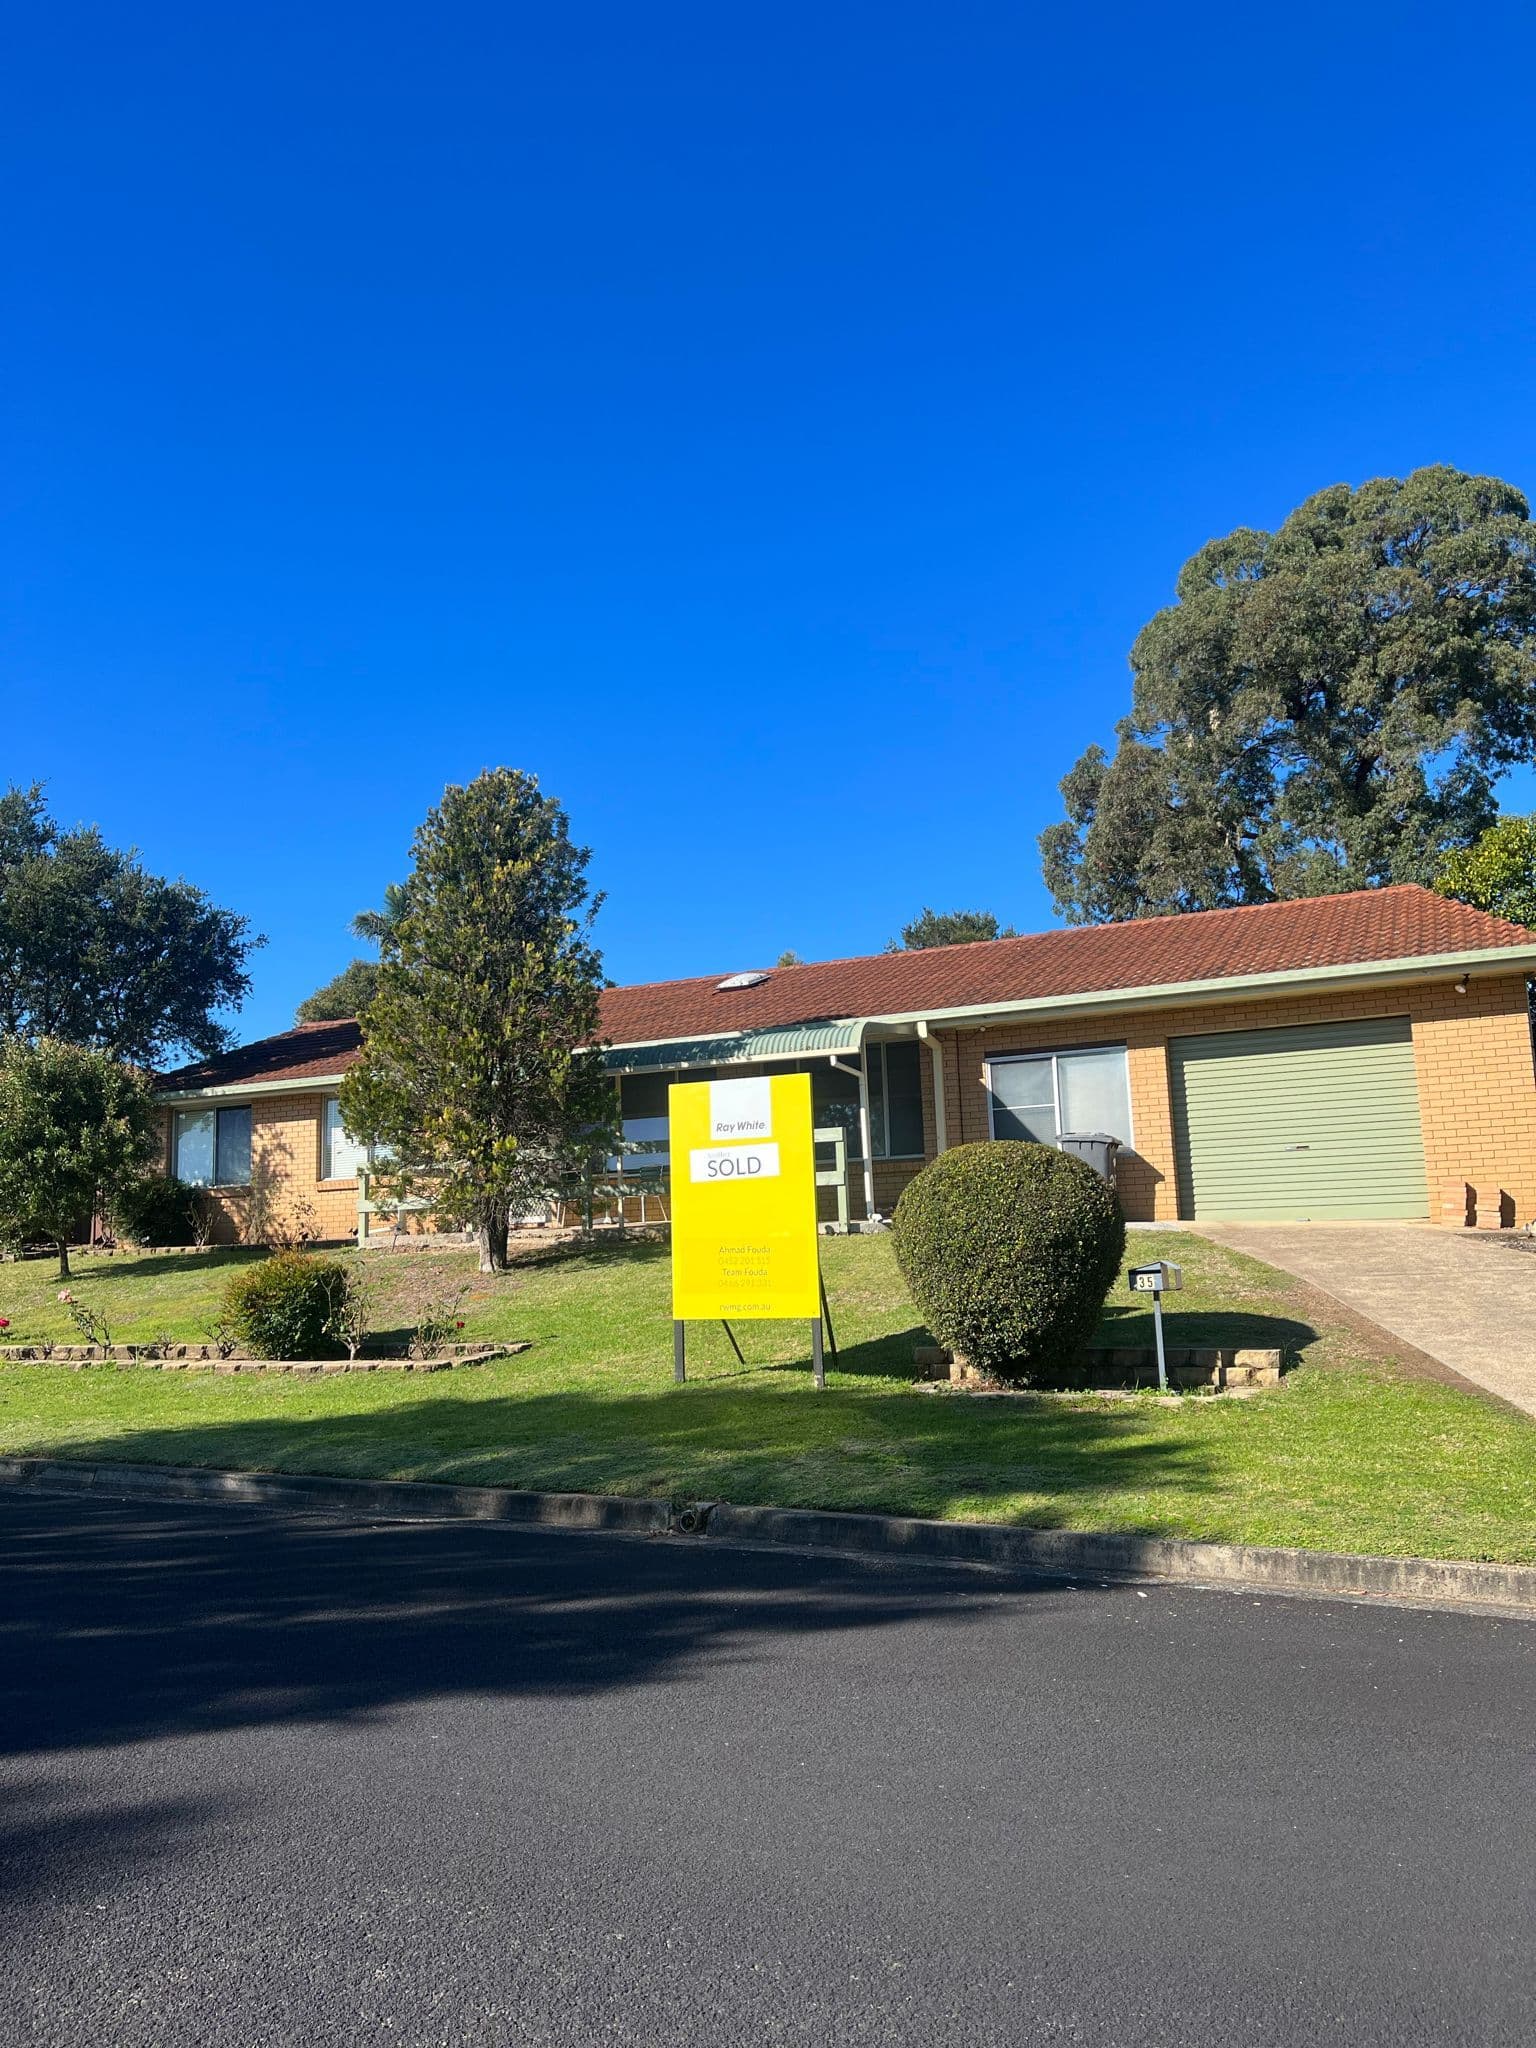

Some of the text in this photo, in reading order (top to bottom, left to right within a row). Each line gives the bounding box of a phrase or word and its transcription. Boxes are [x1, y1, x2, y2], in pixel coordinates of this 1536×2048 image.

[716, 1120, 766, 1133] Ray White
[707, 1156, 762, 1178] SOLD
[722, 1267, 768, 1277] Team Fouda
[1138, 1276, 1153, 1289] 35
